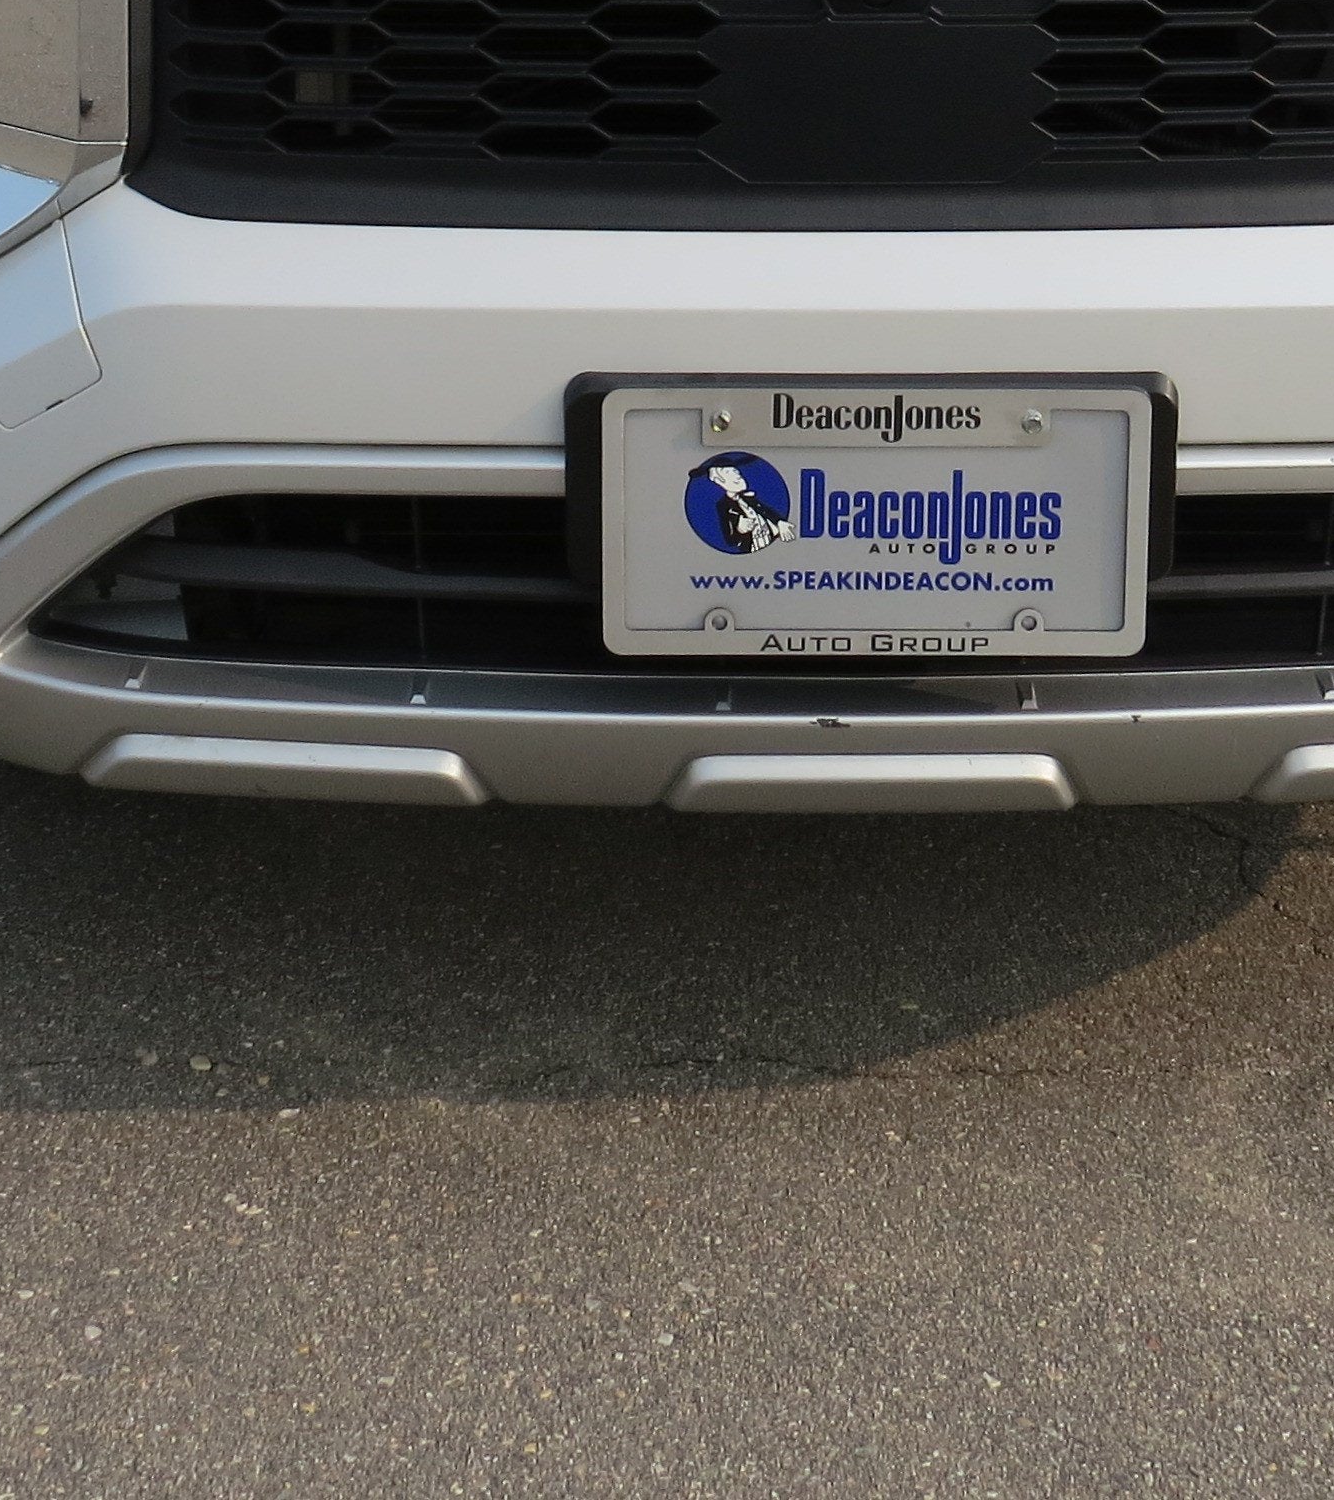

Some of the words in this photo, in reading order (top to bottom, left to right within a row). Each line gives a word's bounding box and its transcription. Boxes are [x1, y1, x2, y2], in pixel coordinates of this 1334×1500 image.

[869, 542, 936, 555] AUTO
[965, 542, 1056, 555] GROUP
[690, 570, 1054, 593] www.SPEAKINDEACON.com
